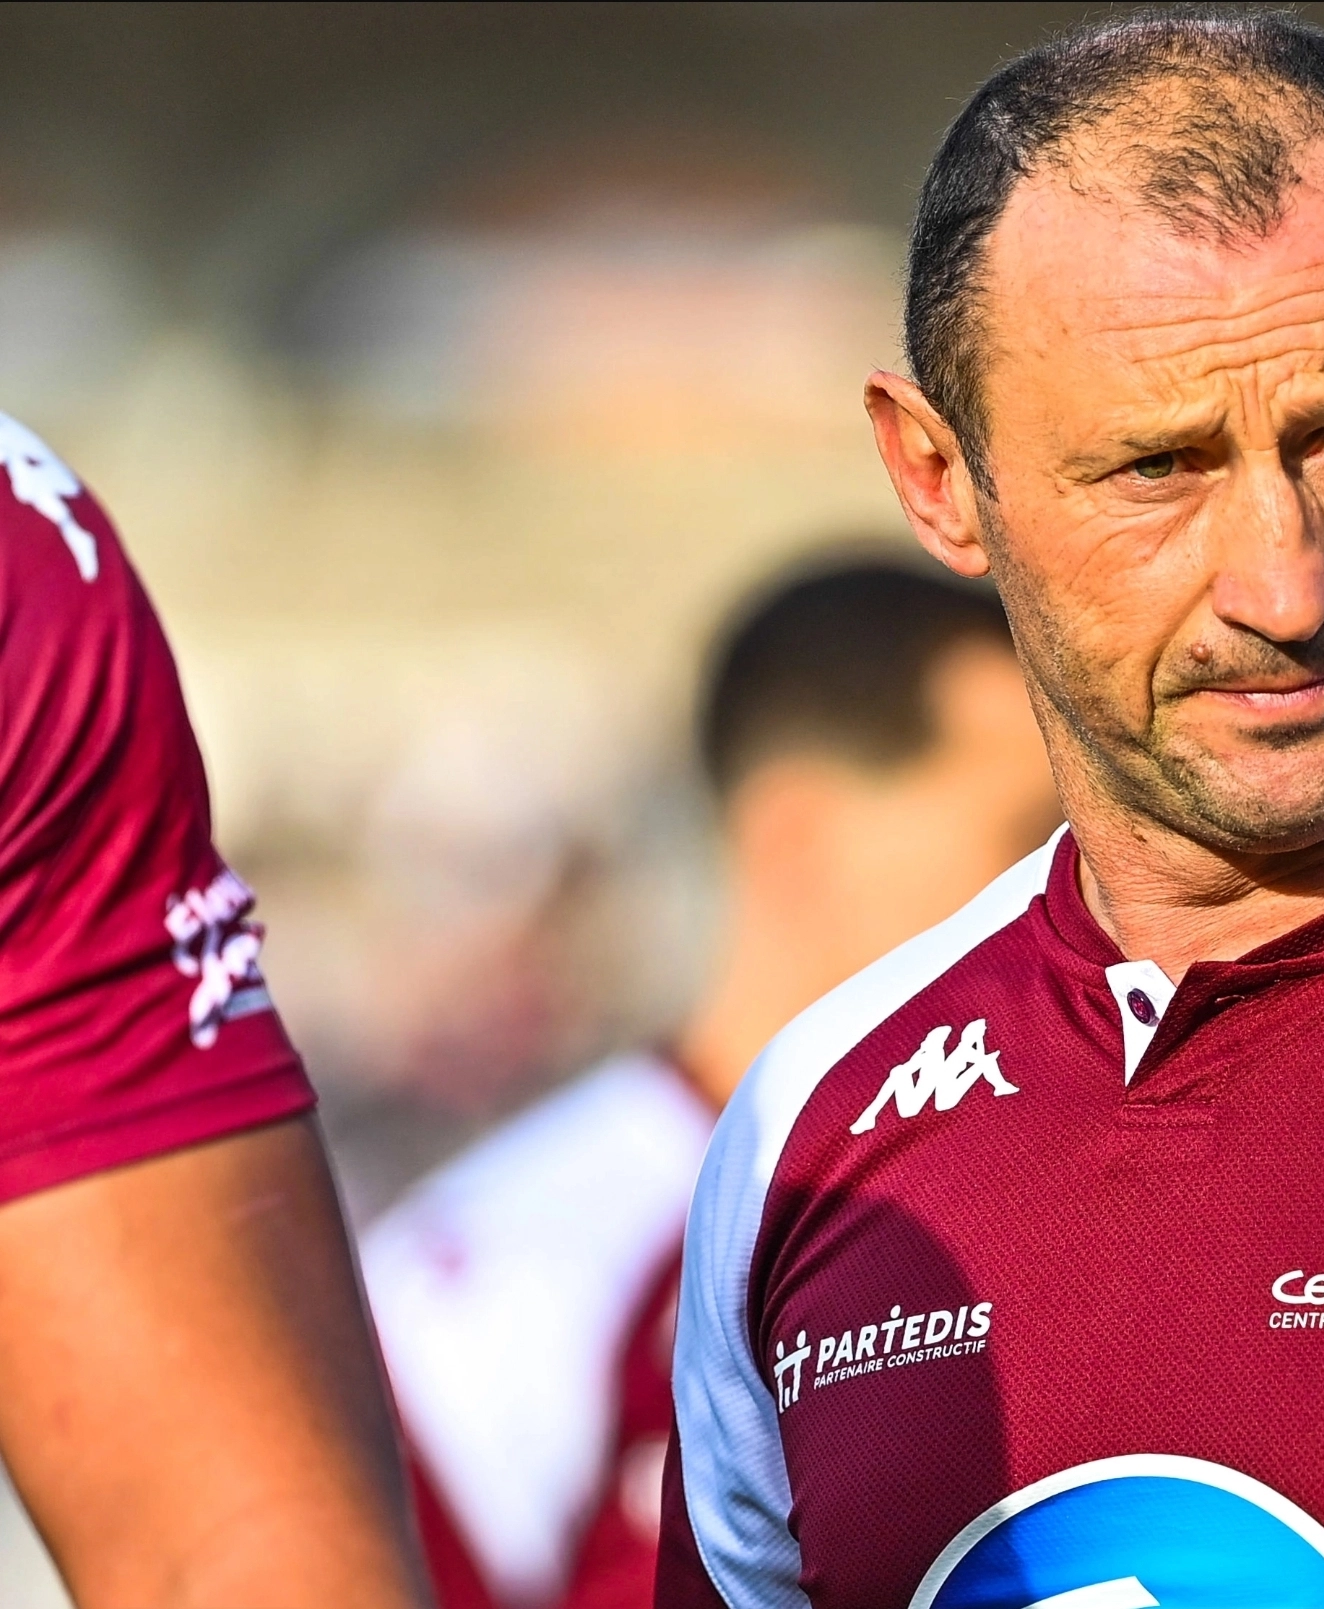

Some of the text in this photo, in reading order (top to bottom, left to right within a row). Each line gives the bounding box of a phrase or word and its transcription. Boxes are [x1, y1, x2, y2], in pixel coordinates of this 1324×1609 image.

[813, 1339, 987, 1390] PARTENAIRE CONSTRUCTIF
[816, 1301, 993, 1374] PARTEDIS
